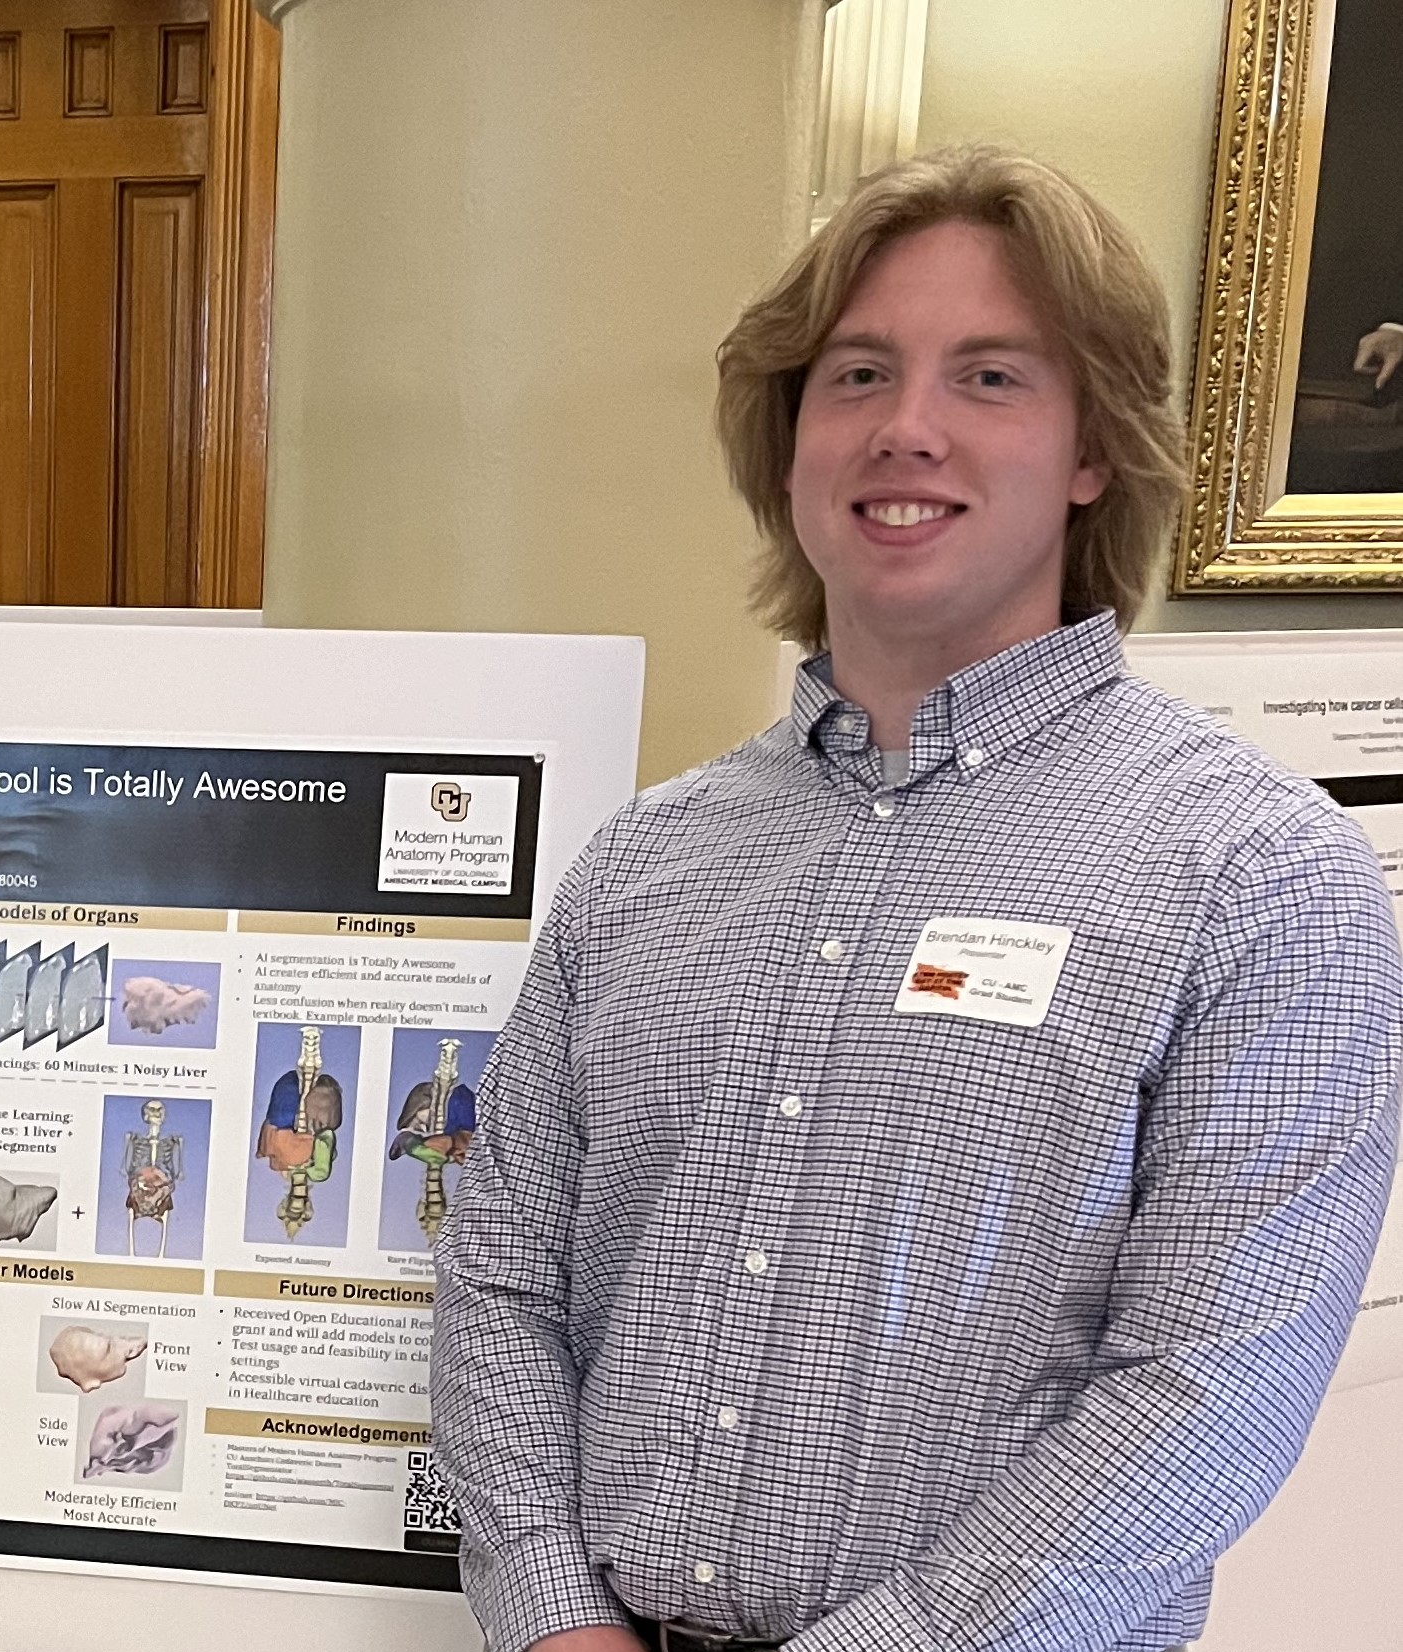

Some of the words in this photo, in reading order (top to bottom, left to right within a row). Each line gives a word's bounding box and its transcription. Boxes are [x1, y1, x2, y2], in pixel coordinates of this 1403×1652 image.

[49, 767, 72, 795] is
[83, 768, 184, 806] Totally
[192, 771, 346, 803] Awesome
[394, 830, 448, 844] Modern
[452, 831, 503, 846] Human
[385, 847, 446, 865] Anatomy
[450, 848, 510, 866] Program
[50, 906, 71, 922] of
[73, 907, 139, 927] Organs
[336, 916, 417, 937] Findings
[925, 930, 987, 944] Brendan
[989, 933, 1056, 955] Hinckley
[254, 952, 268, 963] AI
[269, 955, 345, 966] segmentation
[347, 956, 358, 966] is
[360, 956, 399, 970] Totally
[400, 958, 456, 970] Awesome
[43, 1060, 60, 1071] 60
[63, 1061, 118, 1073] Minutes:
[122, 1064, 129, 1074] 1
[133, 1064, 170, 1078] Noisy
[173, 1066, 207, 1078] Liver
[12, 1109, 73, 1125] Learning:
[23, 1126, 29, 1137] 1
[32, 1126, 63, 1138] liver
[12, 1263, 74, 1281] Models
[279, 1280, 337, 1297] Future
[342, 1284, 435, 1304] Directions
[51, 1297, 83, 1310] Slow
[85, 1299, 100, 1312] AI
[102, 1300, 196, 1318] Segmentation
[233, 1306, 290, 1321] Received
[292, 1310, 327, 1325] Open
[330, 1312, 407, 1329] Educational
[231, 1325, 265, 1337] grant
[268, 1326, 293, 1338] and
[295, 1327, 319, 1339] will
[321, 1328, 345, 1341] add
[348, 1331, 395, 1344] models
[398, 1334, 412, 1345] to
[153, 1341, 191, 1356] Front
[231, 1338, 258, 1351] Test
[260, 1343, 298, 1356] usage
[300, 1343, 325, 1356] and
[327, 1344, 392, 1363] feasibility
[393, 1349, 407, 1361] in
[155, 1359, 188, 1373] View
[228, 1371, 295, 1386] Accessible
[298, 1377, 341, 1389] virtual
[343, 1379, 405, 1394] cadaveric
[227, 1386, 241, 1398] in
[243, 1387, 312, 1403] Healthcare
[315, 1393, 379, 1408] education
[39, 1417, 68, 1431] Side
[37, 1434, 69, 1448] View
[43, 1490, 118, 1509] Moderately
[120, 1496, 177, 1511] Efficient
[63, 1508, 94, 1522] Most
[96, 1511, 157, 1527] Accurate
